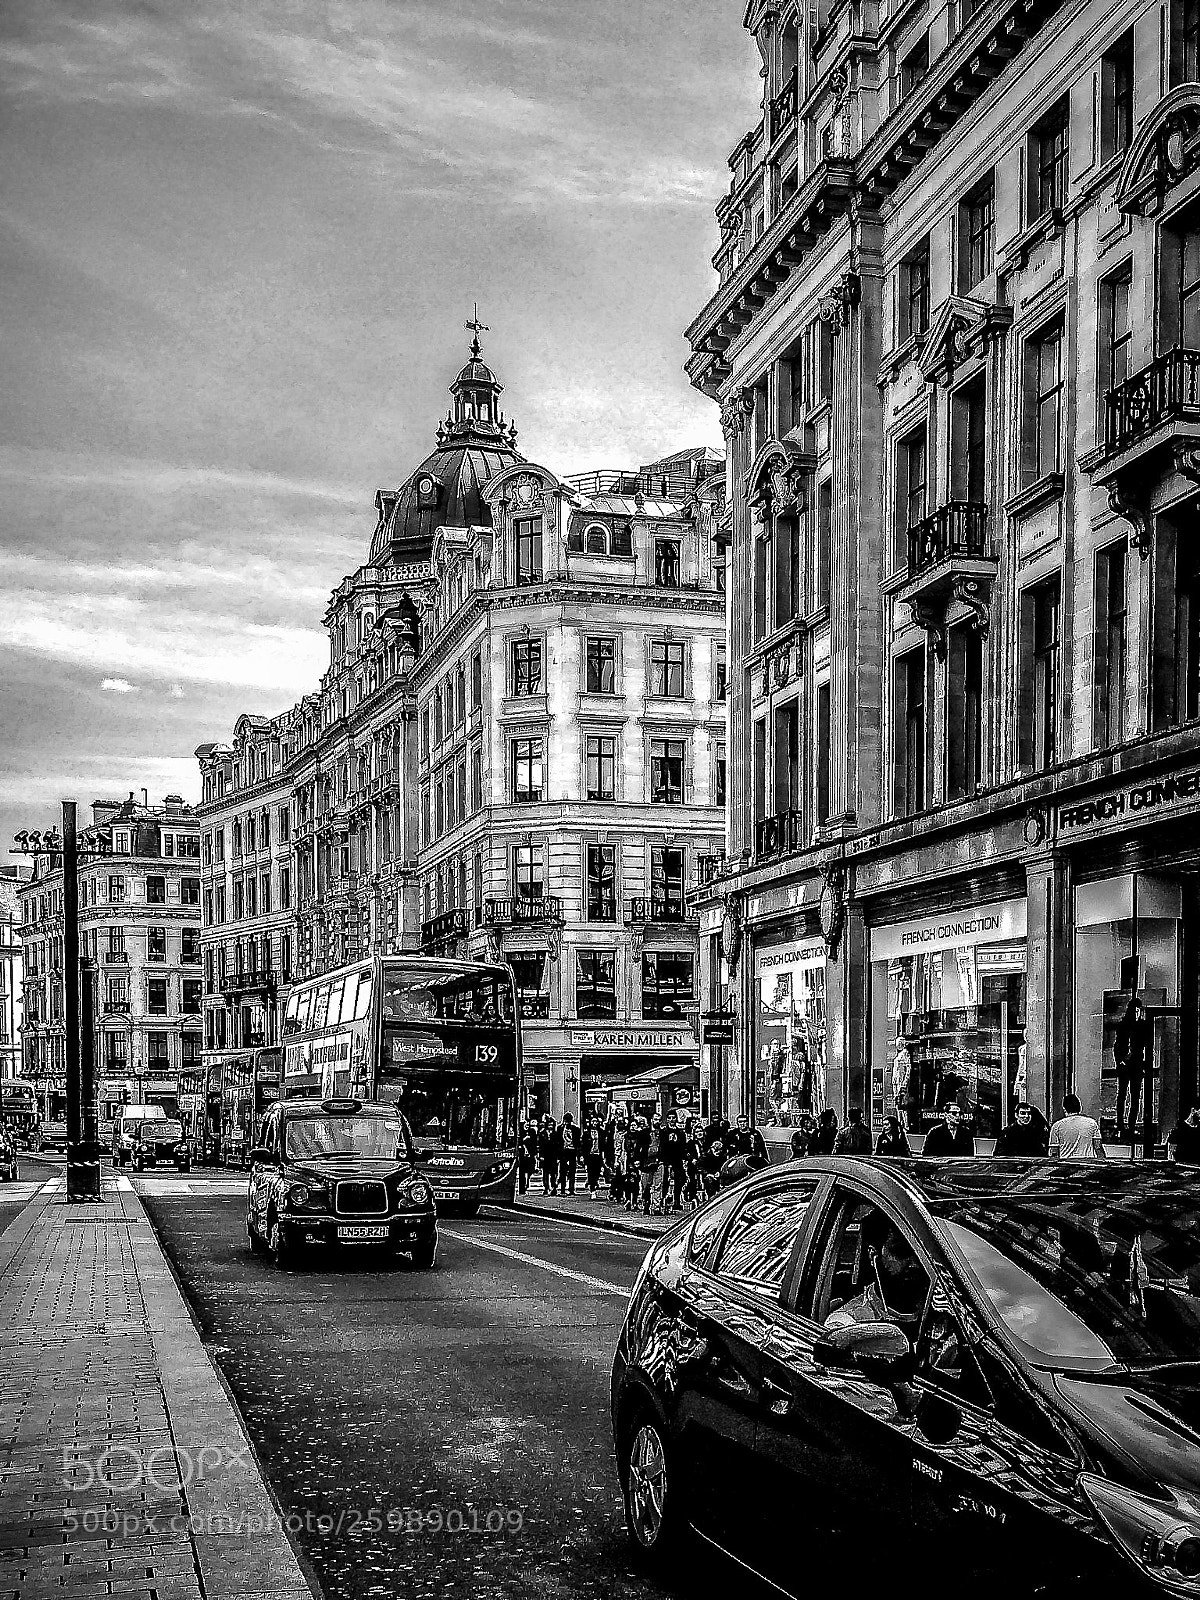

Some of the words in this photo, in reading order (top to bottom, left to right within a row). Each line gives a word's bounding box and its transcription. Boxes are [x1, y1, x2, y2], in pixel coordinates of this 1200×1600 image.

[1060, 793, 1125, 829] FRENCH
[902, 928, 936, 946] FRENCH
[938, 915, 1000, 938] CONNECTION
[760, 954, 784, 968] FRENCH
[784, 945, 829, 963] CONNECTION
[395, 1041, 415, 1053] West
[416, 1043, 458, 1058] Hampstead
[594, 1033, 634, 1046] KAREN
[638, 1034, 683, 1046] MILLEN
[475, 1045, 498, 1062] 139
